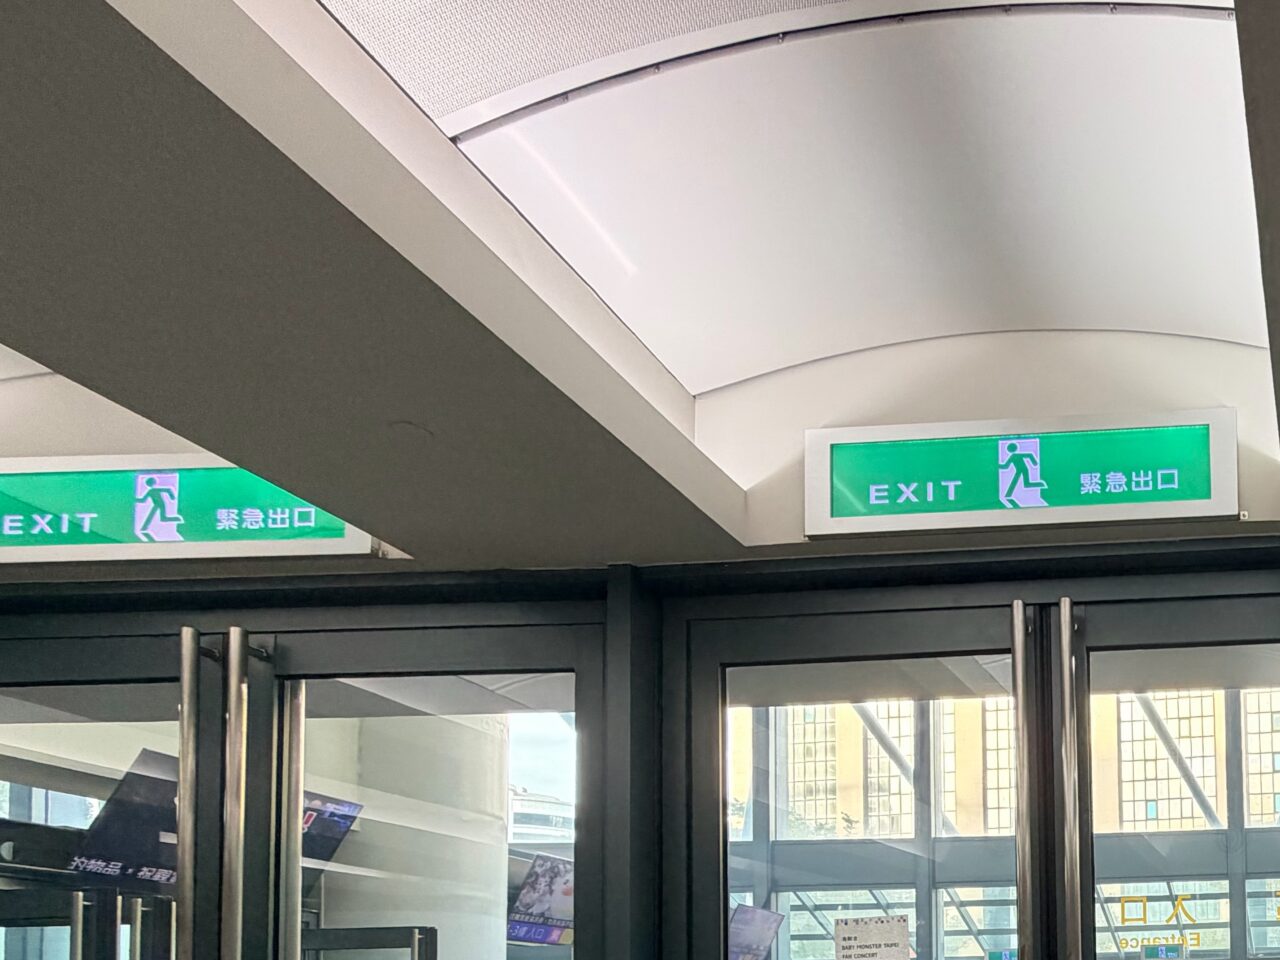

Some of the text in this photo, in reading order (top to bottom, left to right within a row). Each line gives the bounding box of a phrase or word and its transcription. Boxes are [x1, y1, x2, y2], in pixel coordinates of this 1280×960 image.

[869, 480, 962, 504] EXIT
[1080, 469, 1179, 495] 緊急出口
[2, 513, 98, 535] EXIT
[216, 507, 316, 530] 緊急出口
